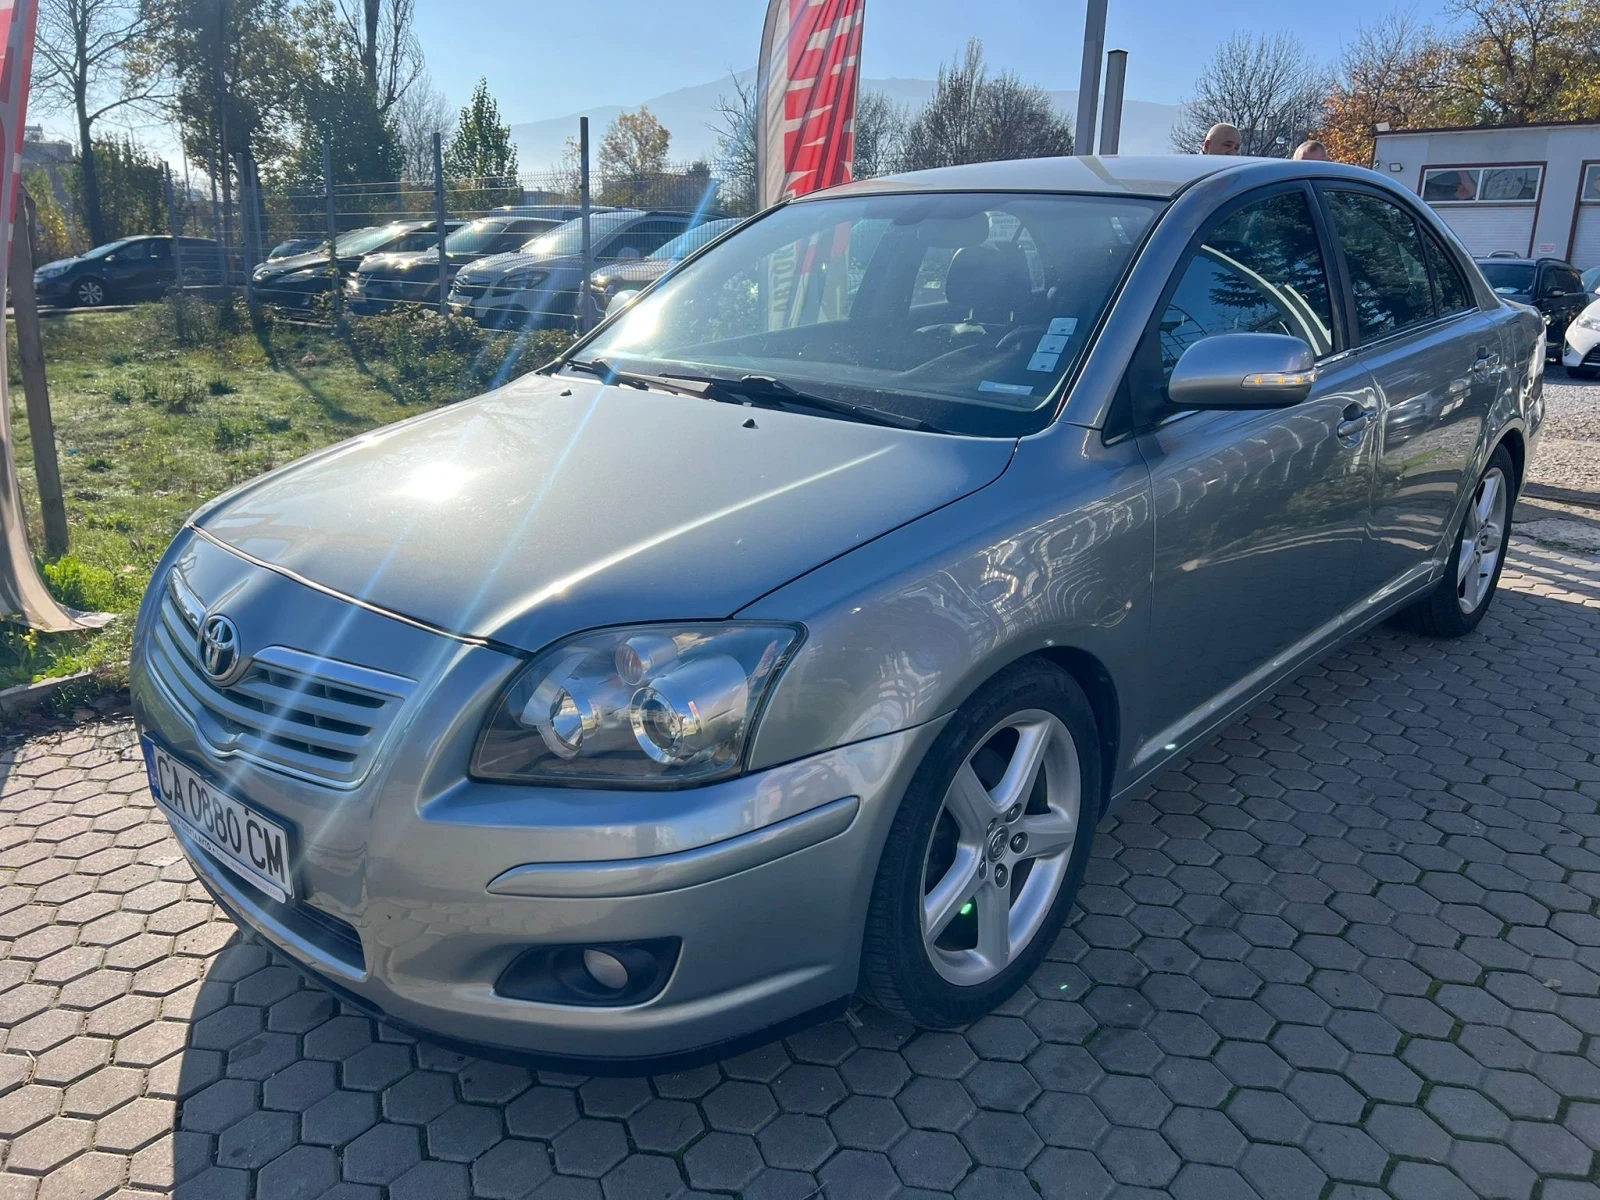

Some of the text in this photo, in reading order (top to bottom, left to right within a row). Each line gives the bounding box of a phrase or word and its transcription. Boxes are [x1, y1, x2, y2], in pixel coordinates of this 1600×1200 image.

[157, 755, 186, 813] CA
[188, 777, 242, 854] 0880
[246, 819, 286, 884] CM
